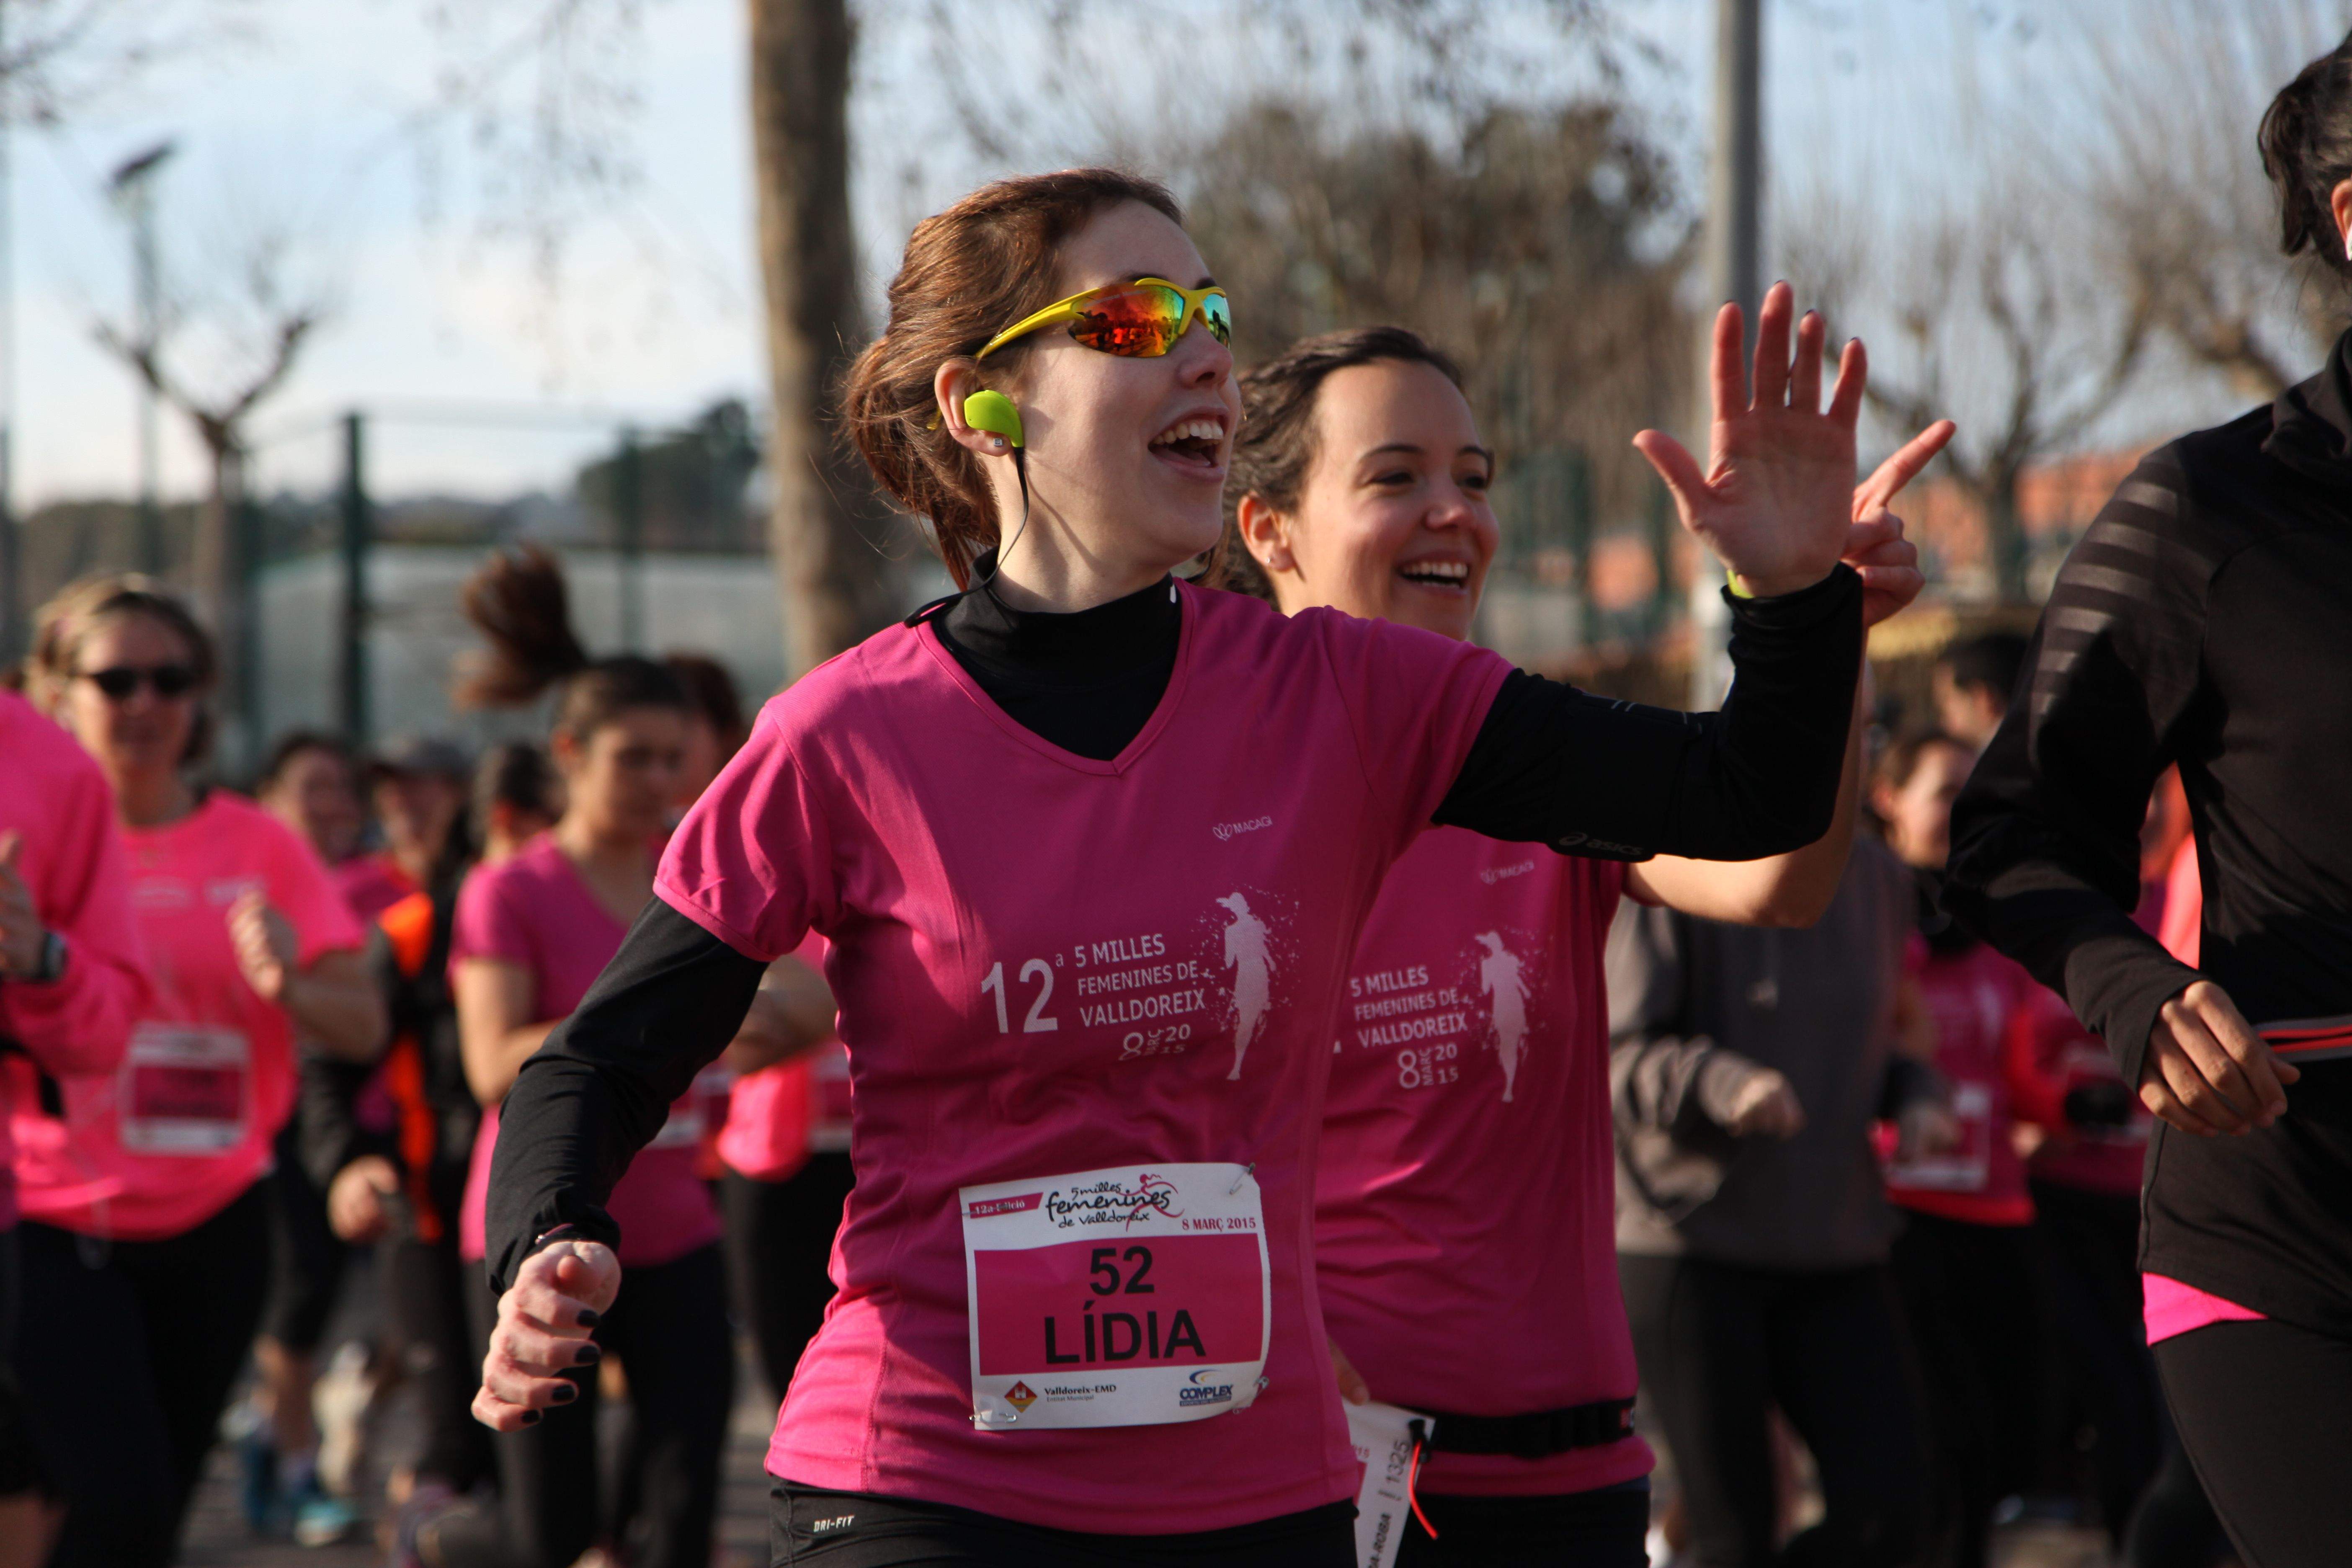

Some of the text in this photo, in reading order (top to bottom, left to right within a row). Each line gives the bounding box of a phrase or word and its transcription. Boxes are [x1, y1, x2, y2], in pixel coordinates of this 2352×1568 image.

[1074, 933, 1166, 968] 5 MILLES
[1077, 960, 1199, 996] FEMENINES DE
[1349, 965, 1429, 998] 5 MILLES
[1079, 988, 1206, 1027] VALLDOREIX
[1354, 987, 1459, 1022] FEMENINES DE
[1165, 1024, 1191, 1042] 20
[1357, 1011, 1468, 1048] VALLDOREIX
[1397, 1050, 1420, 1089] 8
[1435, 1042, 1458, 1061] 20
[1437, 1066, 1459, 1085] 15
[996, 1199, 1025, 1212] Eició
[1045, 1189, 1171, 1222] femenines
[1058, 1214, 1075, 1228] de
[1182, 1216, 1256, 1232] 8 MARÇ 2015
[1090, 1246, 1155, 1296] 52
[1044, 1300, 1207, 1364] LÍDIA
[1044, 1384, 1117, 1396] Valldoreix-EMD
[1179, 1384, 1234, 1400] COMPLEX
[1385, 1438, 1410, 1483] 1325
[813, 1514, 855, 1533] DRI-FIT
